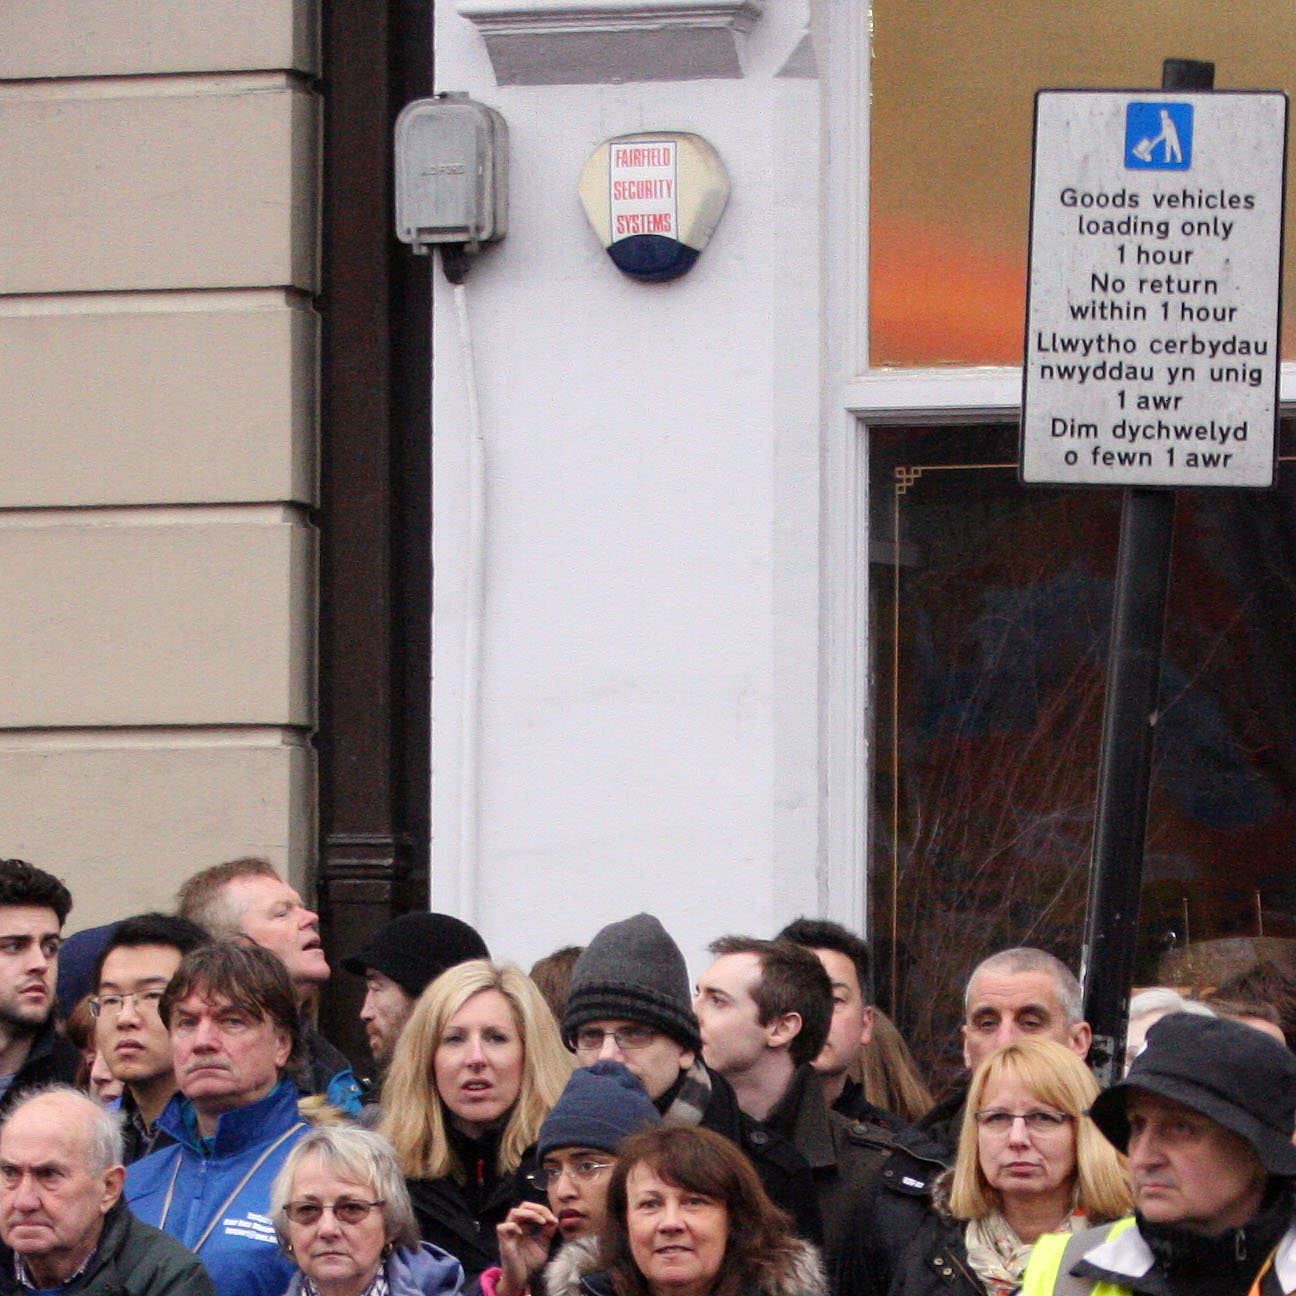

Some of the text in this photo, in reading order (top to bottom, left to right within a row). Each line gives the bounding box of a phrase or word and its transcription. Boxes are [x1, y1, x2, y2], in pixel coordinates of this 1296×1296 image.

[615, 147, 672, 168] FAIRFIELD
[613, 179, 673, 201] SECURITY
[1060, 188, 1256, 210] Goods vehicles
[616, 213, 672, 234] SYSTEMS
[1078, 215, 1234, 241] loading only
[1117, 245, 1193, 265] 1 hour
[1091, 273, 1218, 294] No return
[1070, 301, 1238, 322] within 1 hour
[1037, 332, 1269, 358] Llwytho cerbydau
[1040, 360, 1263, 387] nwyddau yn unig
[1117, 390, 1183, 411] 1 awr
[1051, 417, 1248, 445] Dim dychwelyd
[1064, 445, 1233, 469] o fewn 1 awr
